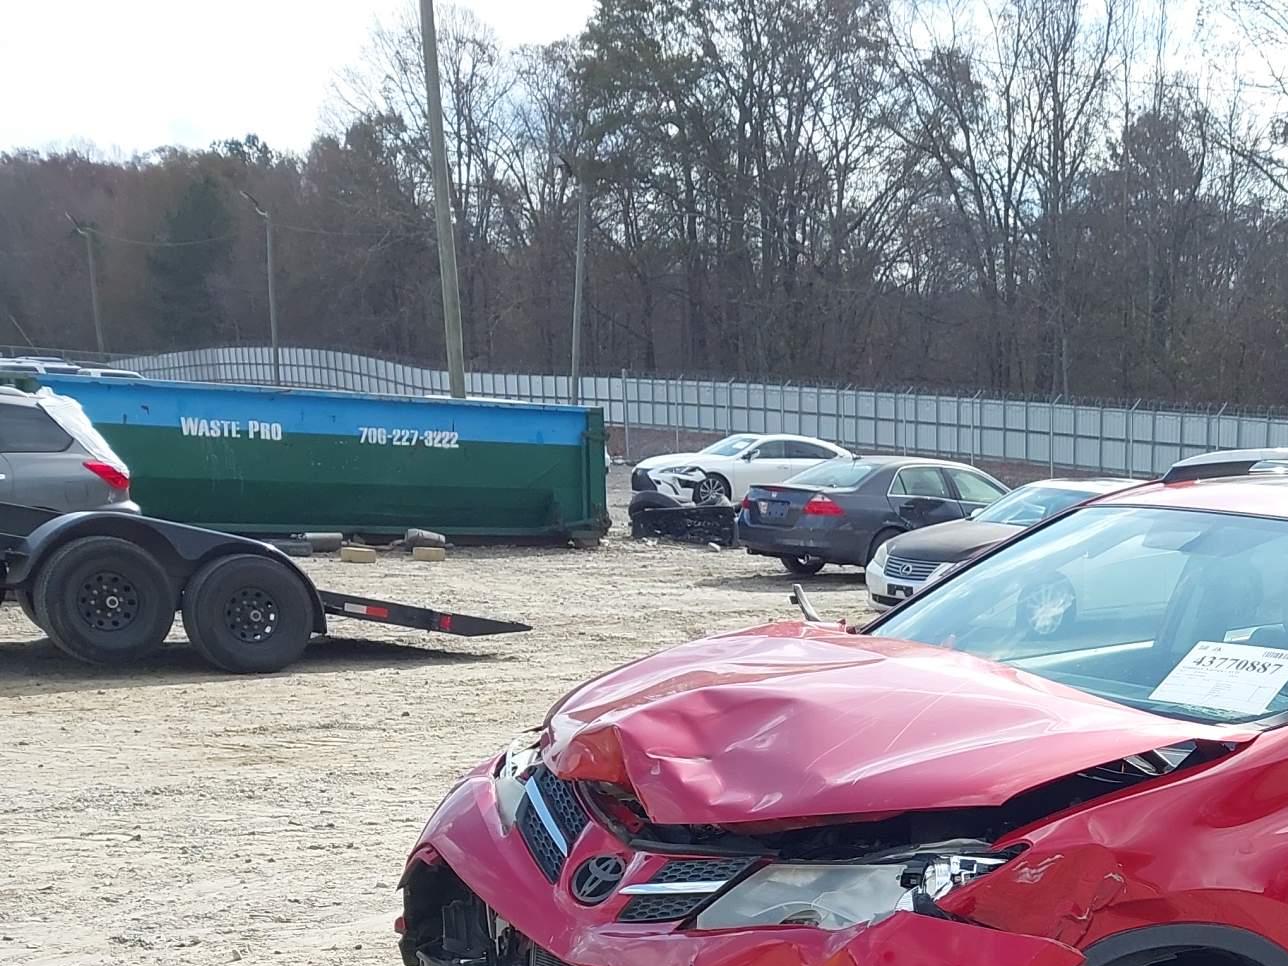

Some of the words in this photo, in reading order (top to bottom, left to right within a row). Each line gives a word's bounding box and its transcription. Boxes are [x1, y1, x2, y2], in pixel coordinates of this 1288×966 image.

[180, 416, 241, 438] WASTE
[248, 420, 282, 441] PRO
[358, 427, 459, 448] 706-227-3222
[1193, 655, 1283, 675] 43770887
